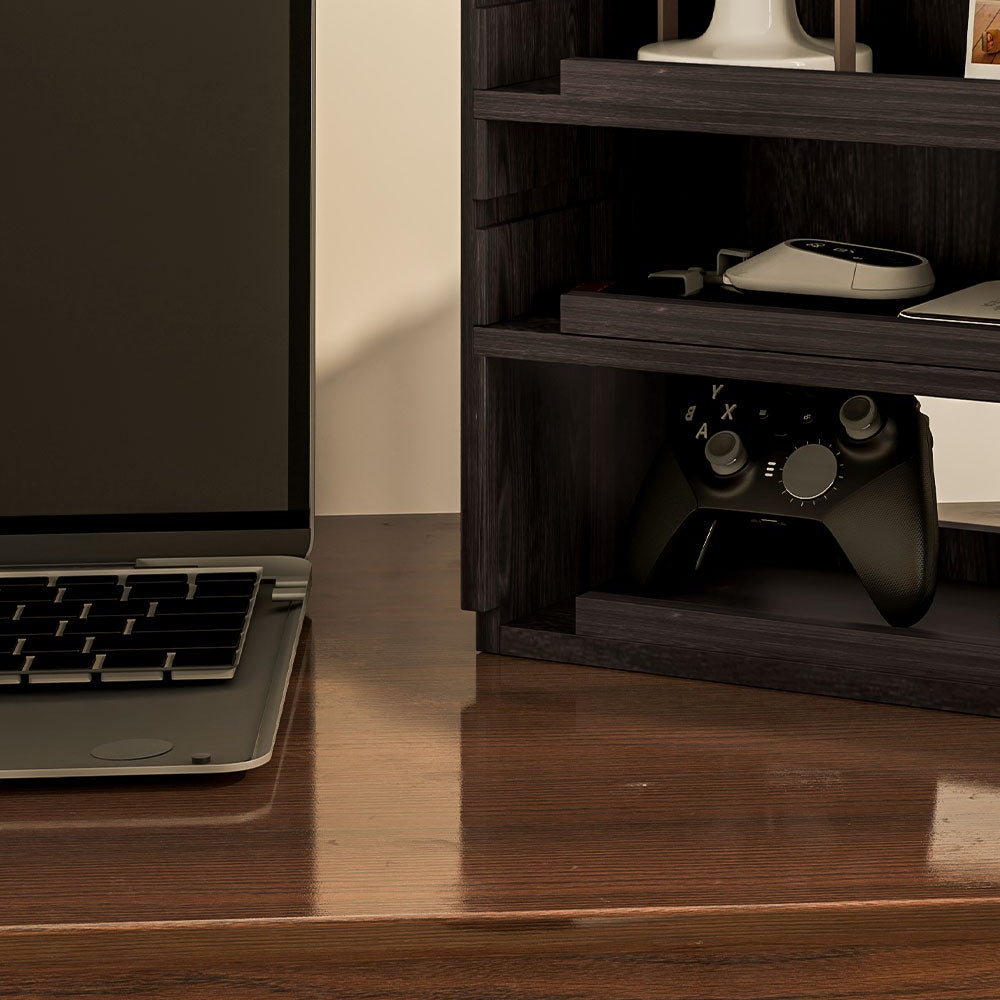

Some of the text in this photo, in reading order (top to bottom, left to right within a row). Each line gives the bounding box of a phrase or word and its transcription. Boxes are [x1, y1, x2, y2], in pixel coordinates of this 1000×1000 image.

[712, 384, 724, 400] Y
[721, 403, 737, 420] X
[696, 422, 708, 439] A
